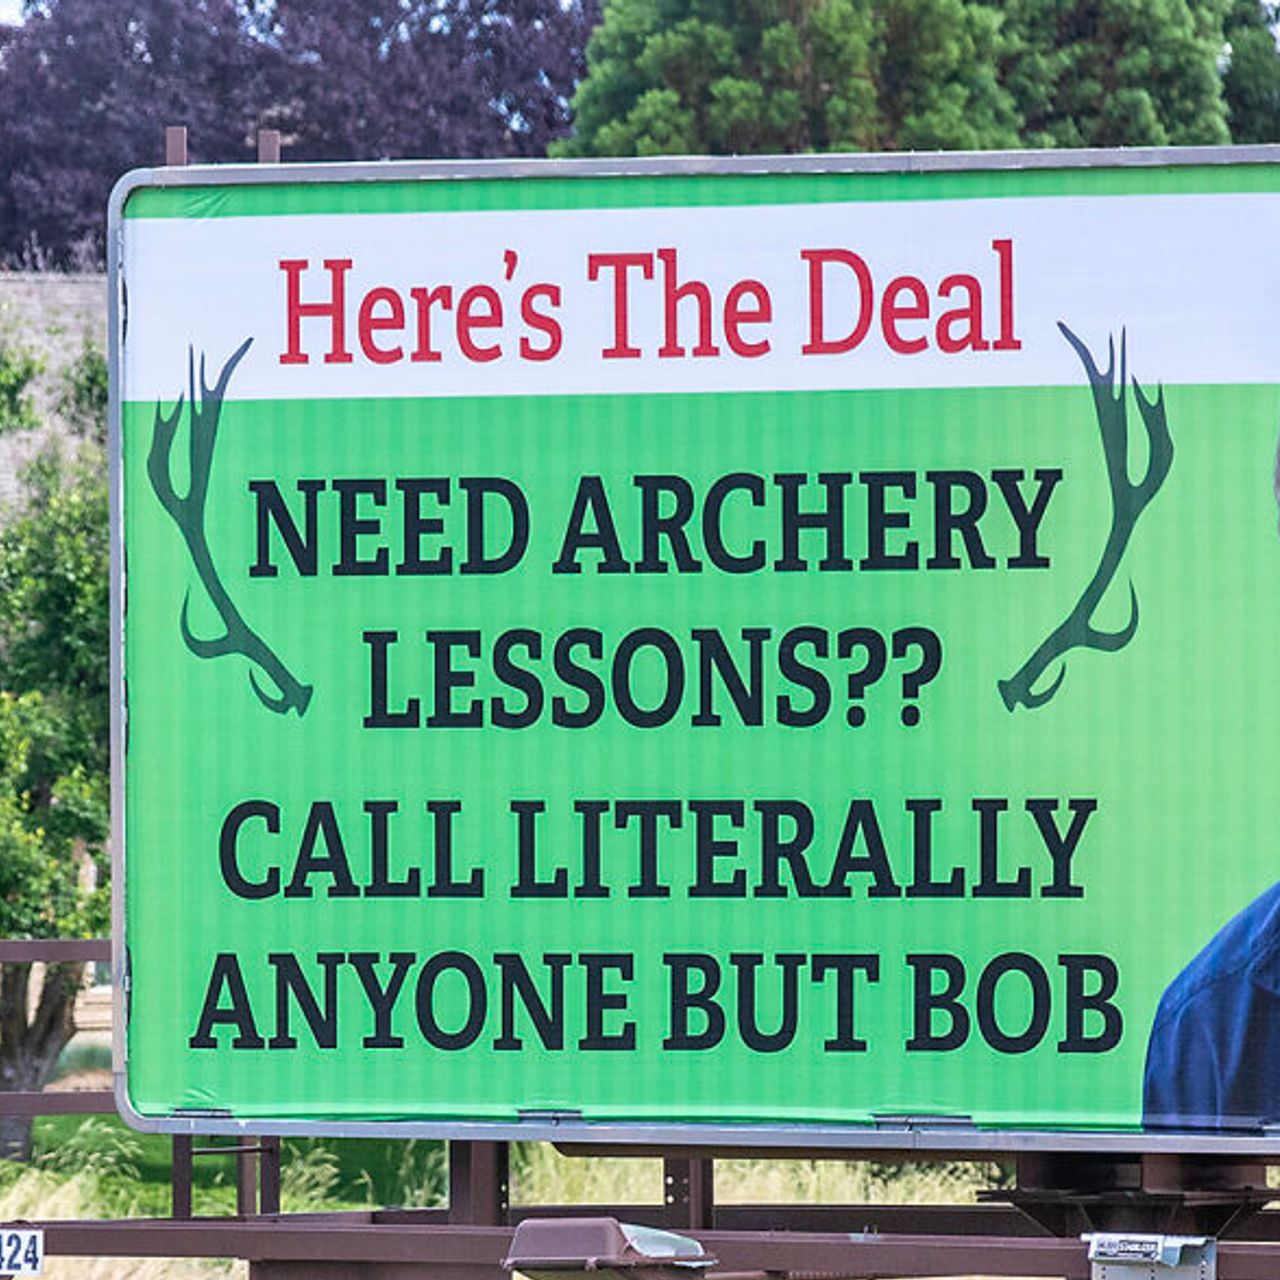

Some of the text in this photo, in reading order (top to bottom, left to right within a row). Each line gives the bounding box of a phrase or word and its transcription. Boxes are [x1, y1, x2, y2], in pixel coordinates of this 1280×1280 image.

[280, 240, 1021, 364] Here's The Deal
[249, 469, 1062, 577] NEED ARCHERY
[363, 626, 942, 729] LESSONS??
[220, 799, 1097, 899] CALL LITERALLY
[190, 951, 1123, 1054] ANYONE BUT BOB
